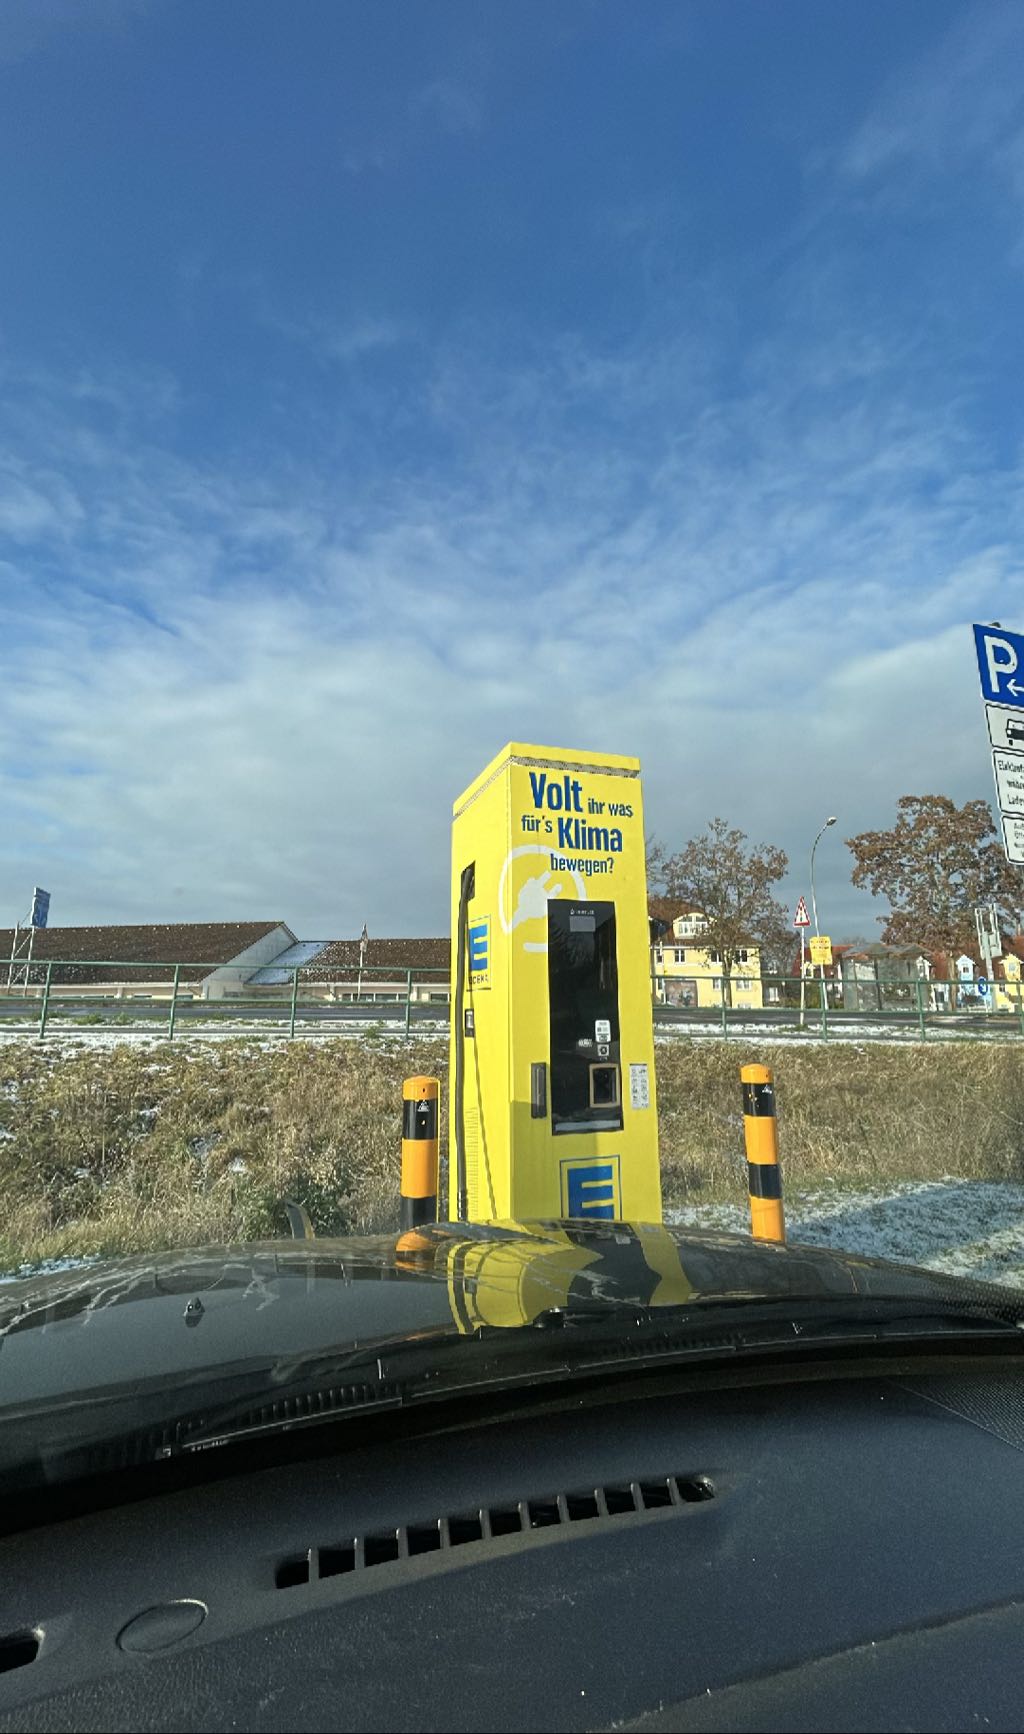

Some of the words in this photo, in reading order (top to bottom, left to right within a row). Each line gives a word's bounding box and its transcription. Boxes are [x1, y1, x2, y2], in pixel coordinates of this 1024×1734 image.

[984, 635, 1018, 693] P
[529, 772, 583, 812] Volt
[588, 798, 605, 814] ihr
[608, 803, 633, 818] was
[521, 815, 552, 833] für's
[558, 817, 623, 852] Klima
[550, 853, 614, 876] bewegen?
[568, 1165, 615, 1219] E
